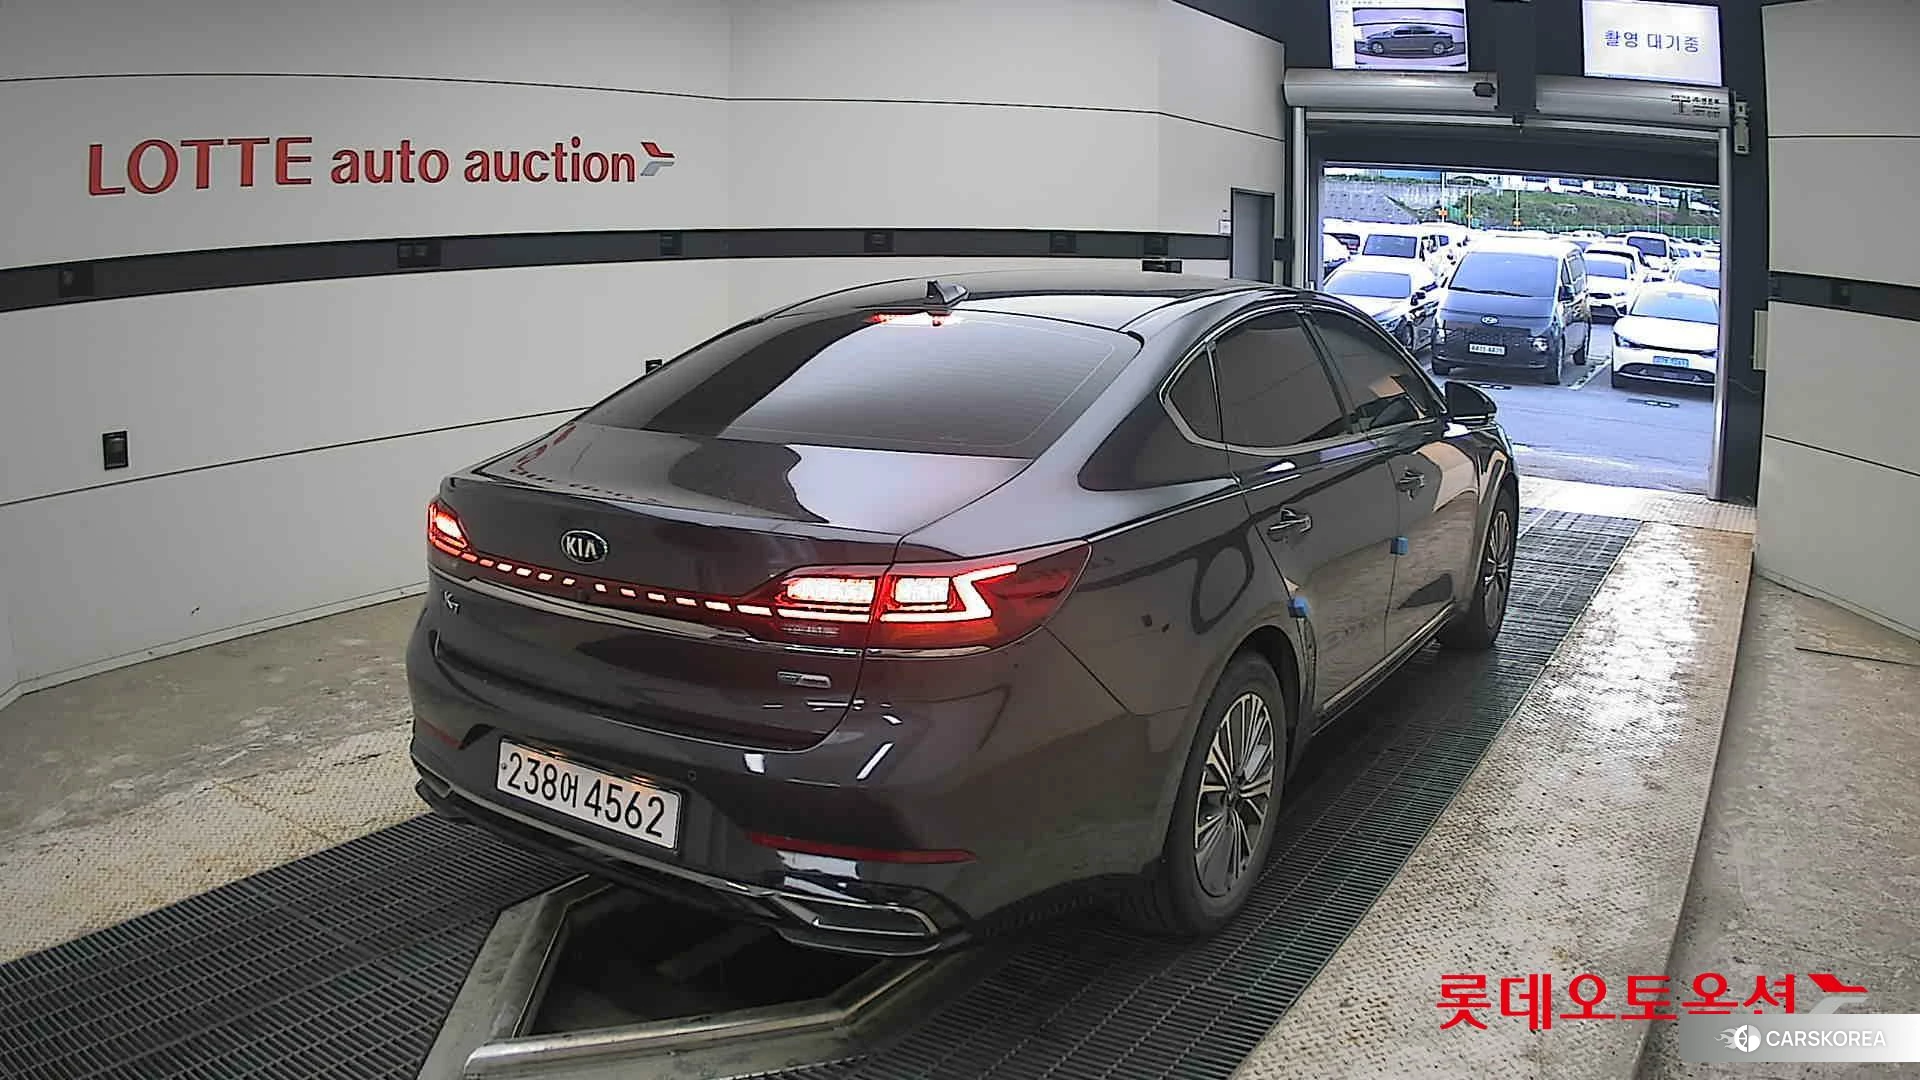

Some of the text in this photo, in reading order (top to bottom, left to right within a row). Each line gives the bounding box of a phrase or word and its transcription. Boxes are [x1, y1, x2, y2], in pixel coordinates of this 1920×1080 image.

[1605, 30, 1699, 53] 촬영 대기중
[89, 135, 637, 196] LOTTE auto auction
[565, 536, 598, 559] KIA
